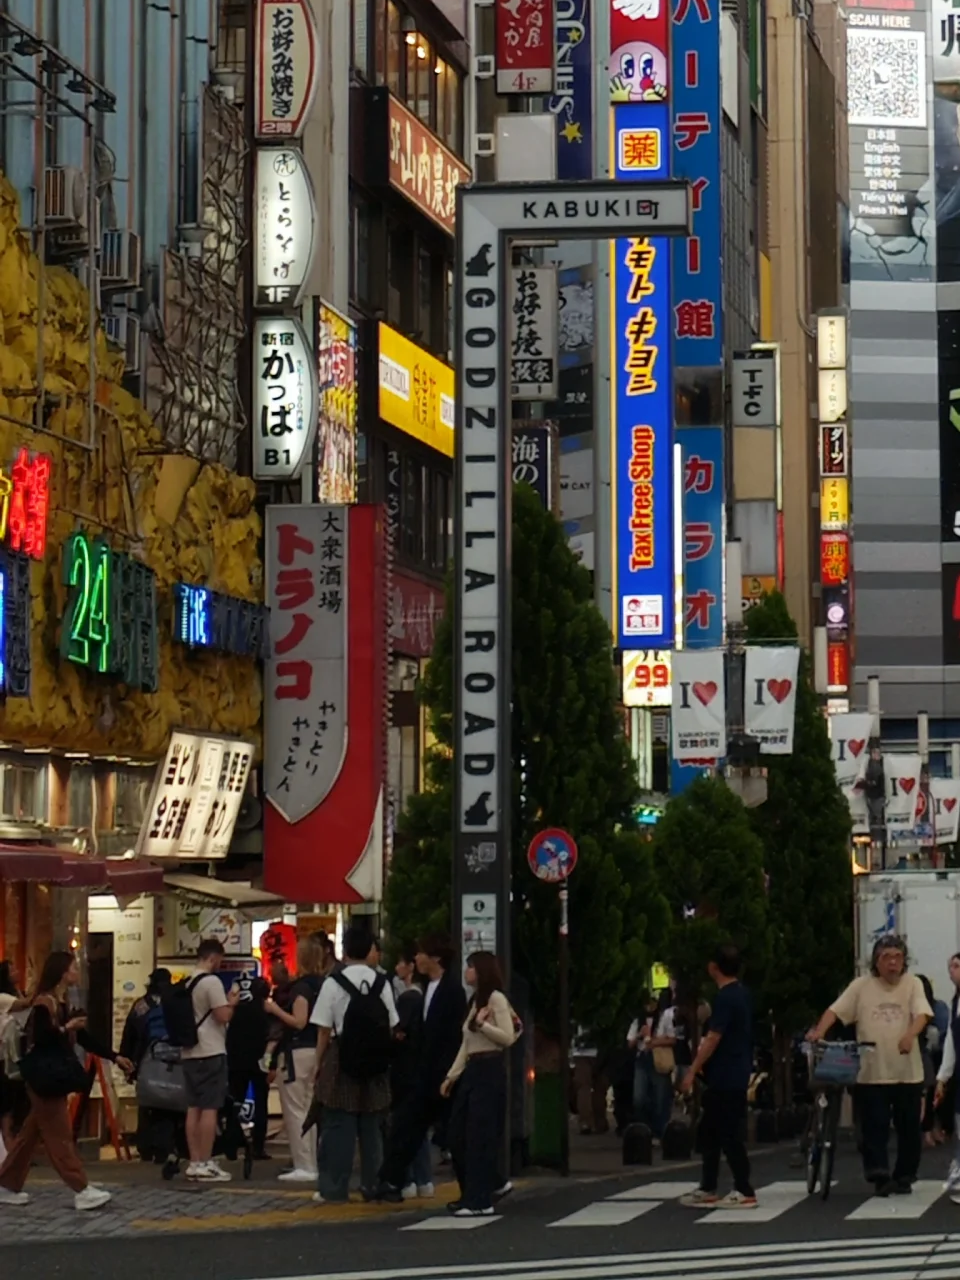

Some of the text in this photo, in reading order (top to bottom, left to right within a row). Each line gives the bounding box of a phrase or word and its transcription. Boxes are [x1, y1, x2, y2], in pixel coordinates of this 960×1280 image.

[849, 14, 911, 28] SCAN HERE
[271, 8, 294, 118] お好み焼き
[512, 71, 538, 91] 4F
[620, 133, 659, 166] 薬
[864, 142, 900, 153] English
[523, 200, 660, 220] KABUKI町
[264, 287, 291, 303] 1F
[624, 237, 658, 397] モトキヨシ
[261, 332, 294, 346] 新宿
[264, 449, 292, 466] B1
[830, 427, 844, 465] ダーツ
[629, 426, 654, 572] Tax Free Shop
[464, 287, 496, 777] GODZILLA ROAD
[318, 511, 344, 614] 大衆酒場
[67, 534, 110, 673] 24
[274, 523, 316, 702] トラノコ
[680, 682, 691, 709] I
[754, 678, 766, 705] I
[275, 716, 311, 794] やきとん
[306, 700, 338, 777] やきとり
